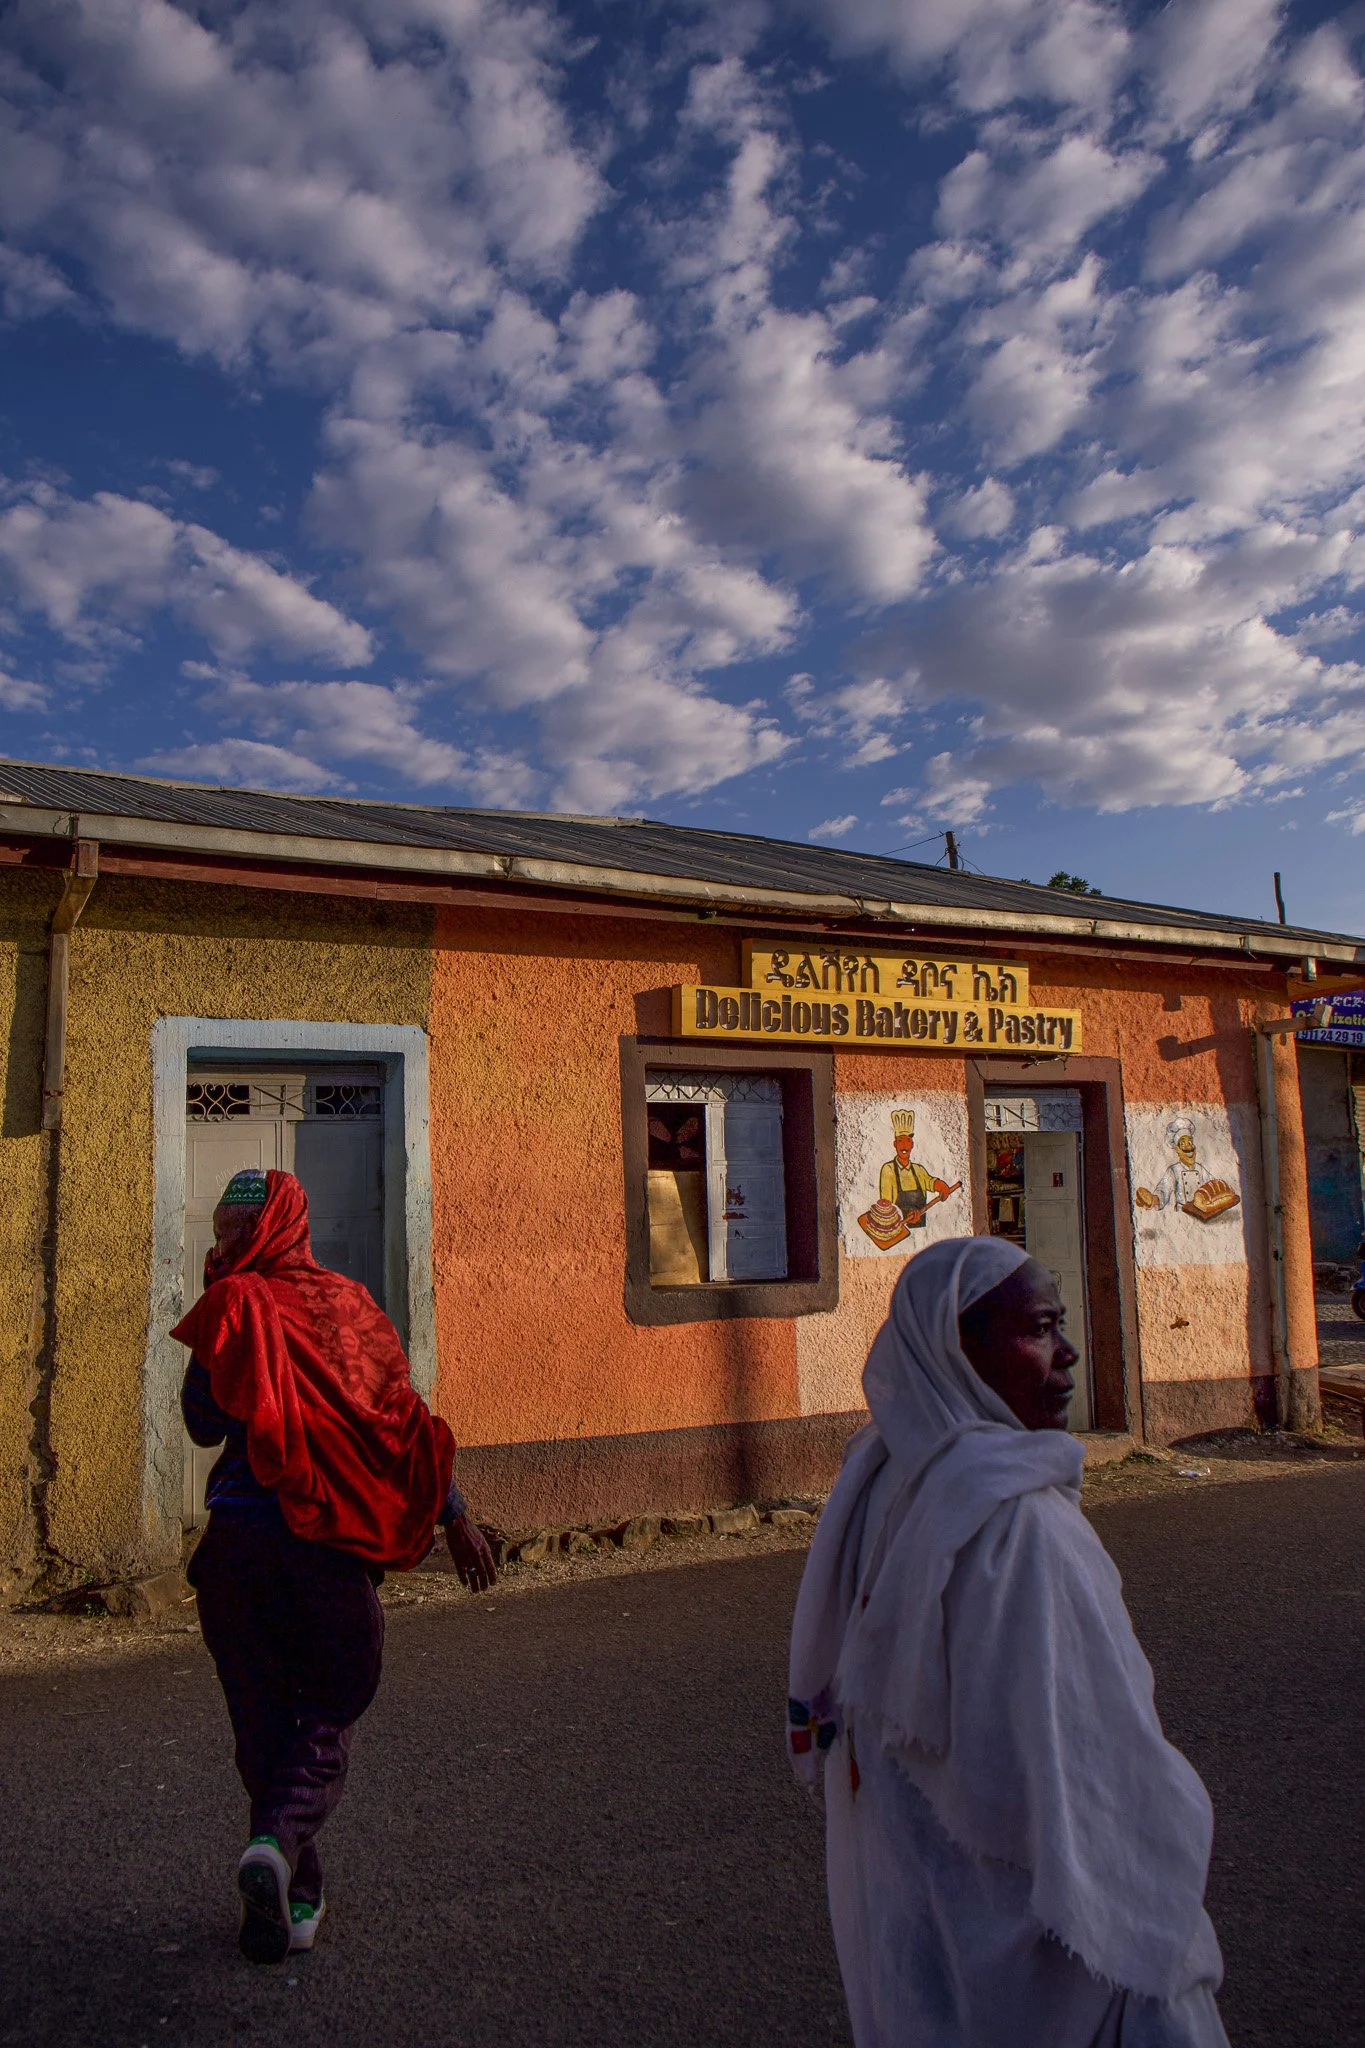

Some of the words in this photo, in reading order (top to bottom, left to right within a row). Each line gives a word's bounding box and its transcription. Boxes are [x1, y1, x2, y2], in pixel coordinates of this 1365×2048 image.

[896, 959, 958, 999] ዳቦና
[971, 963, 1017, 1004] ኬክ
[696, 988, 850, 1036] Delicious
[855, 999, 959, 1045] Bakery
[963, 1011, 984, 1043] &
[988, 1007, 1073, 1050] Pastry
[1320, 1030, 1333, 1041] 24
[1335, 1031, 1349, 1042] 29
[1350, 1032, 1363, 1043] 19
